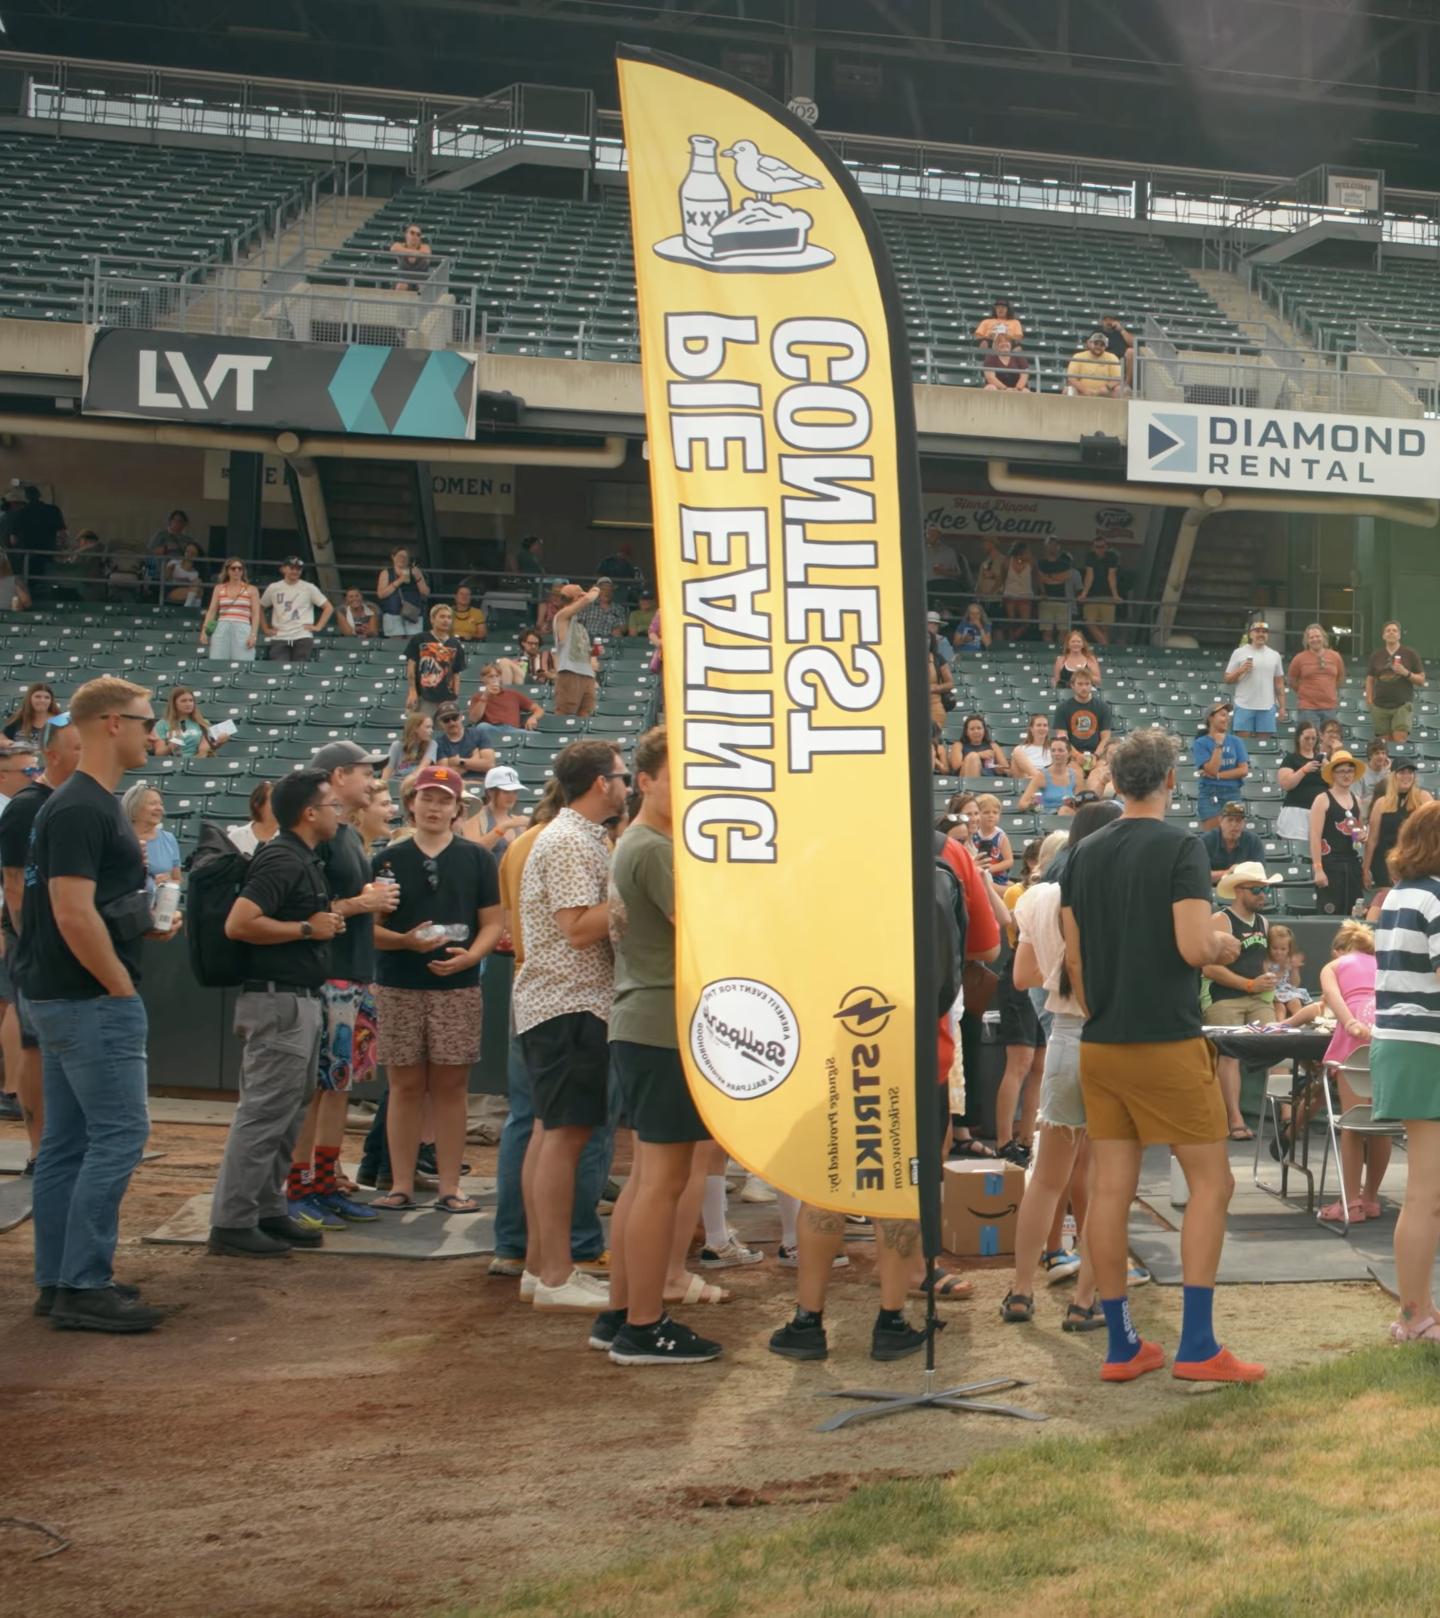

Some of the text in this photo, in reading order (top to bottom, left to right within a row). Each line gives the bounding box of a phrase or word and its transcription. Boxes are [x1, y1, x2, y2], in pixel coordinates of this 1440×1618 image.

[1334, 182, 1373, 192] WELCOME
[138, 350, 273, 412] LVT
[1209, 416, 1426, 457] DIAMOND
[1208, 453, 1375, 484] RENTAL
[432, 476, 494, 496] OMEN
[953, 498, 1039, 513] Hand Dipped
[924, 507, 1056, 535] Ice Cream
